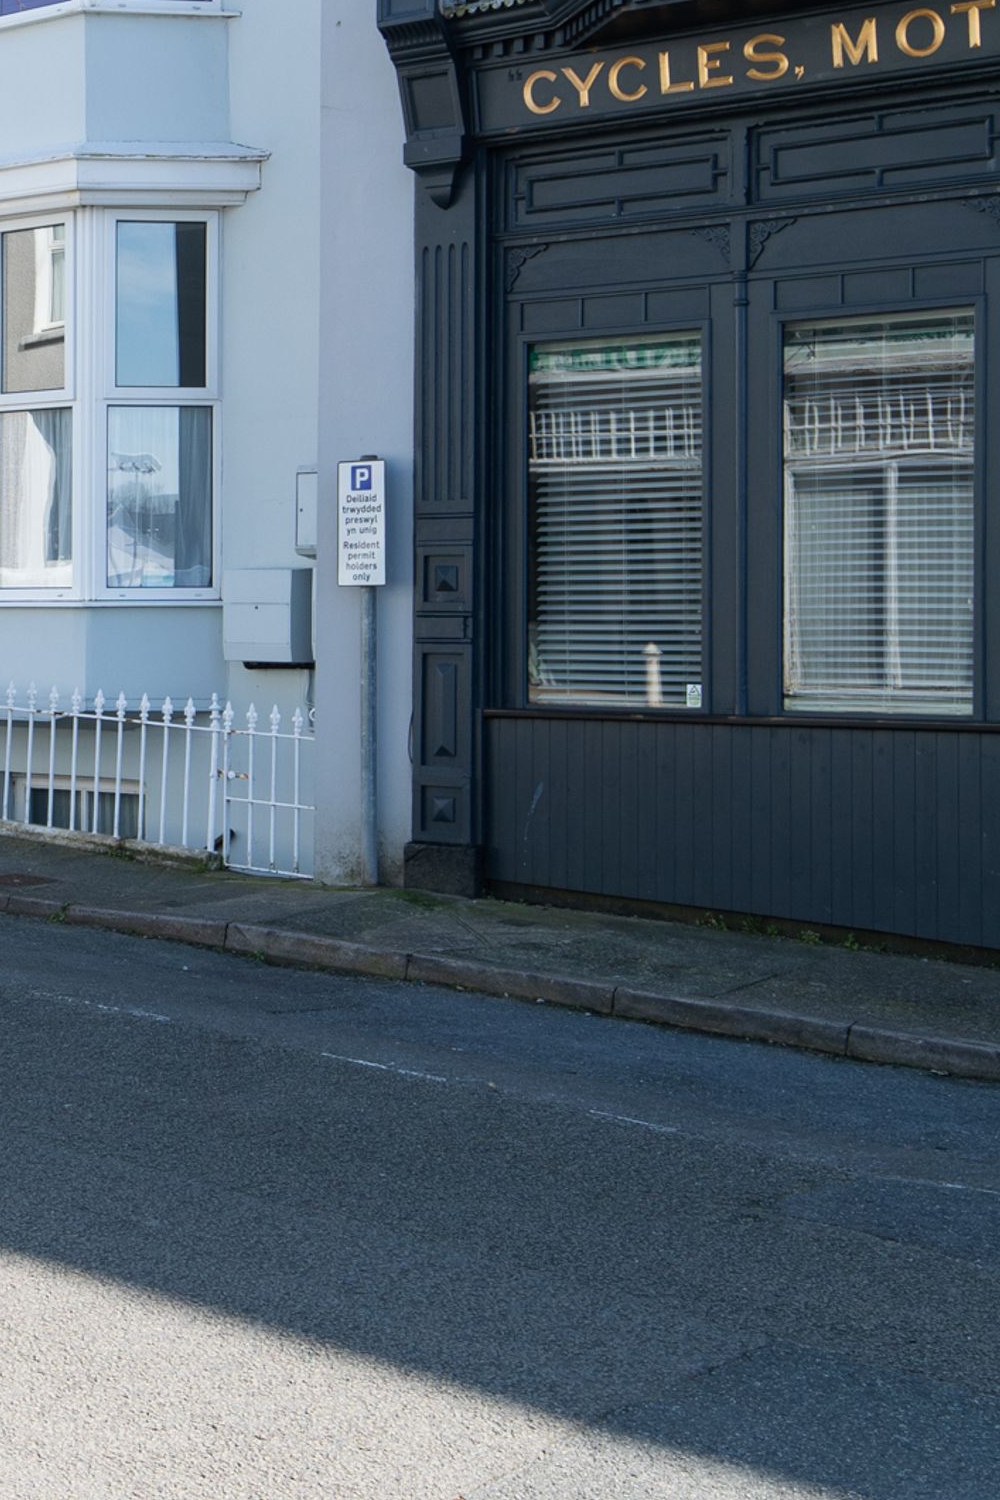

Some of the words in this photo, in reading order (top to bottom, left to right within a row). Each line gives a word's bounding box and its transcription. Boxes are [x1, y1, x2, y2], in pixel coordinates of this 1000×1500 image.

[355, 468, 369, 489] P
[346, 494, 377, 503] Deiliaid
[342, 504, 382, 514] trwydded
[345, 515, 378, 525] preswyl
[346, 527, 356, 536] yn
[359, 525, 377, 535] unig
[343, 541, 380, 549] Resident
[347, 551, 375, 561] permit
[345, 561, 378, 570] holders
[352, 573, 371, 582] only
